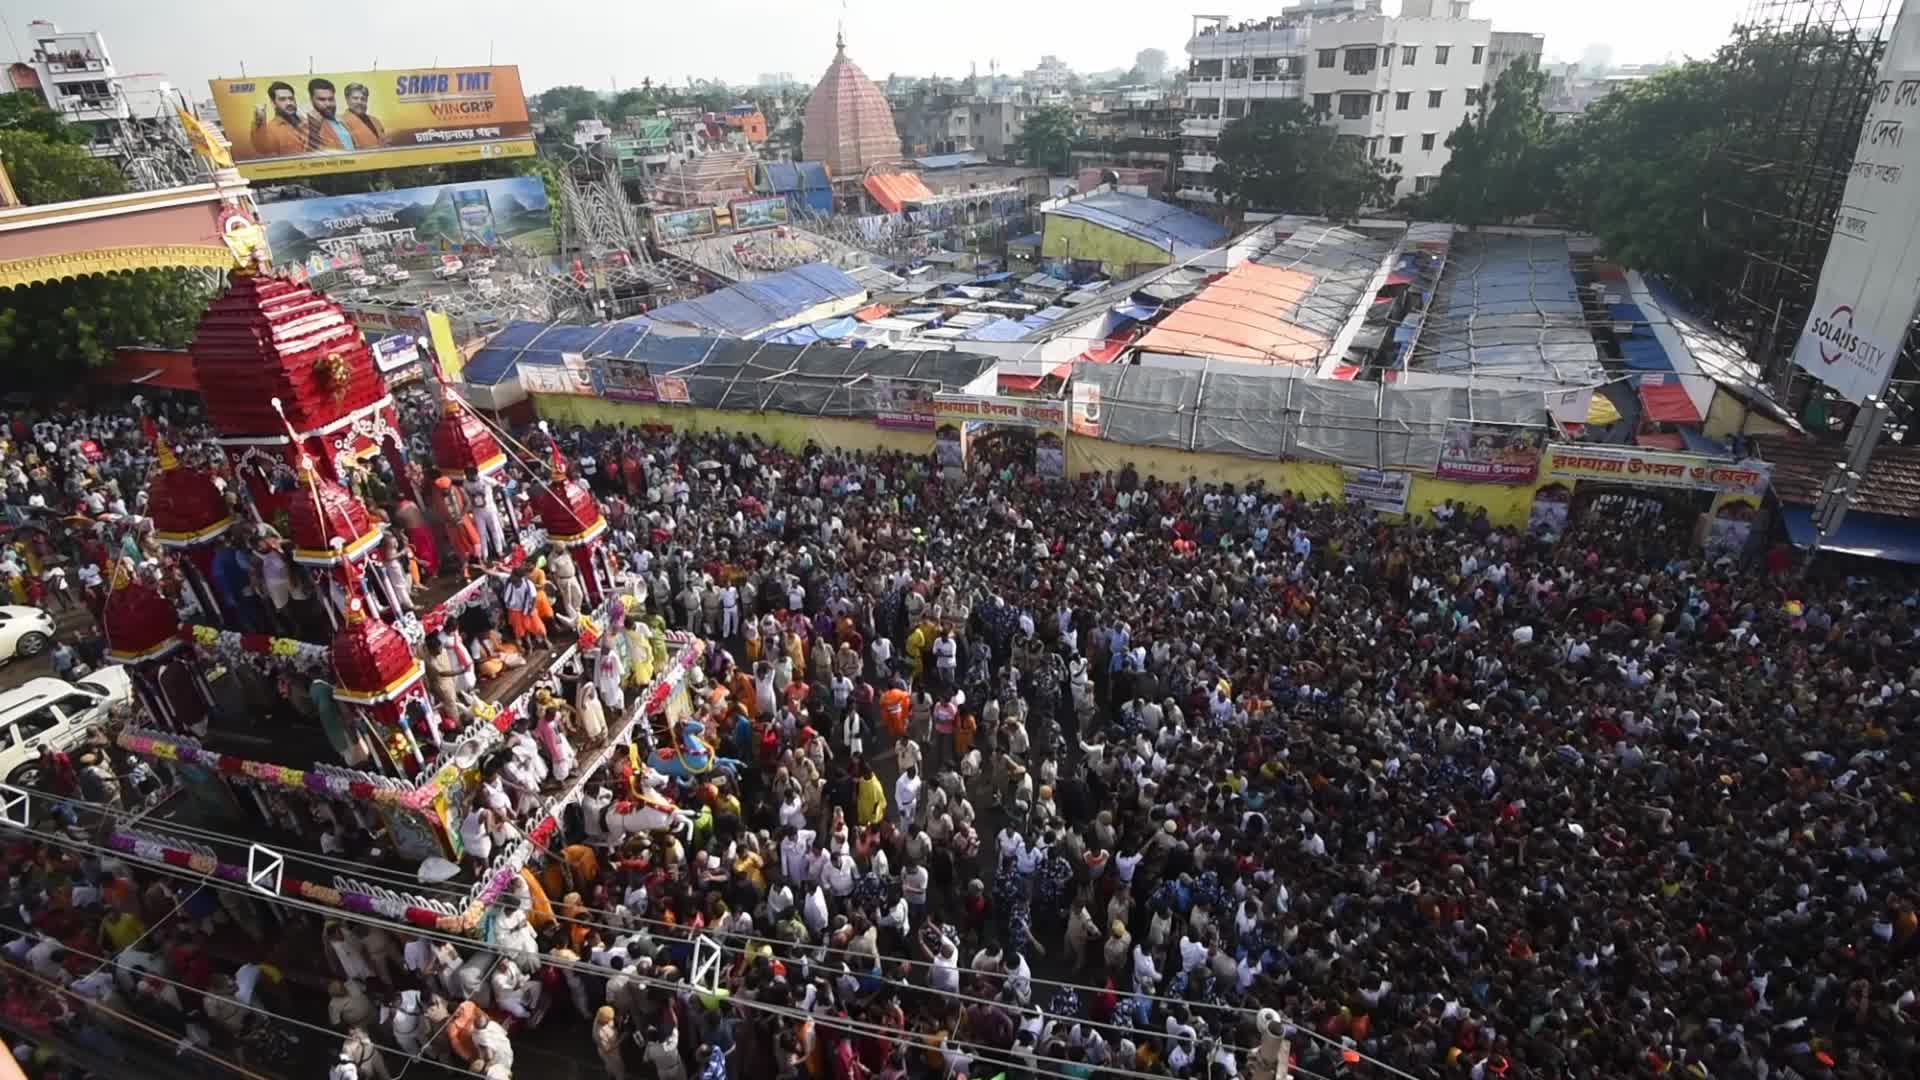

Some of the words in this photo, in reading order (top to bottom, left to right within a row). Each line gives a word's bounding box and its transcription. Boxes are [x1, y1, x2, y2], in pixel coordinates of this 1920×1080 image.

[396, 74, 449, 95] SRMB
[456, 72, 491, 91] TMT
[430, 100, 494, 115] WINGRIP
[1857, 341, 1886, 368] CITY
[1552, 454, 1622, 473] রথযাত্রা
[1627, 458, 1686, 478] উৎসব
[1690, 467, 1707, 480] ও
[1711, 468, 1761, 488] মেলা
